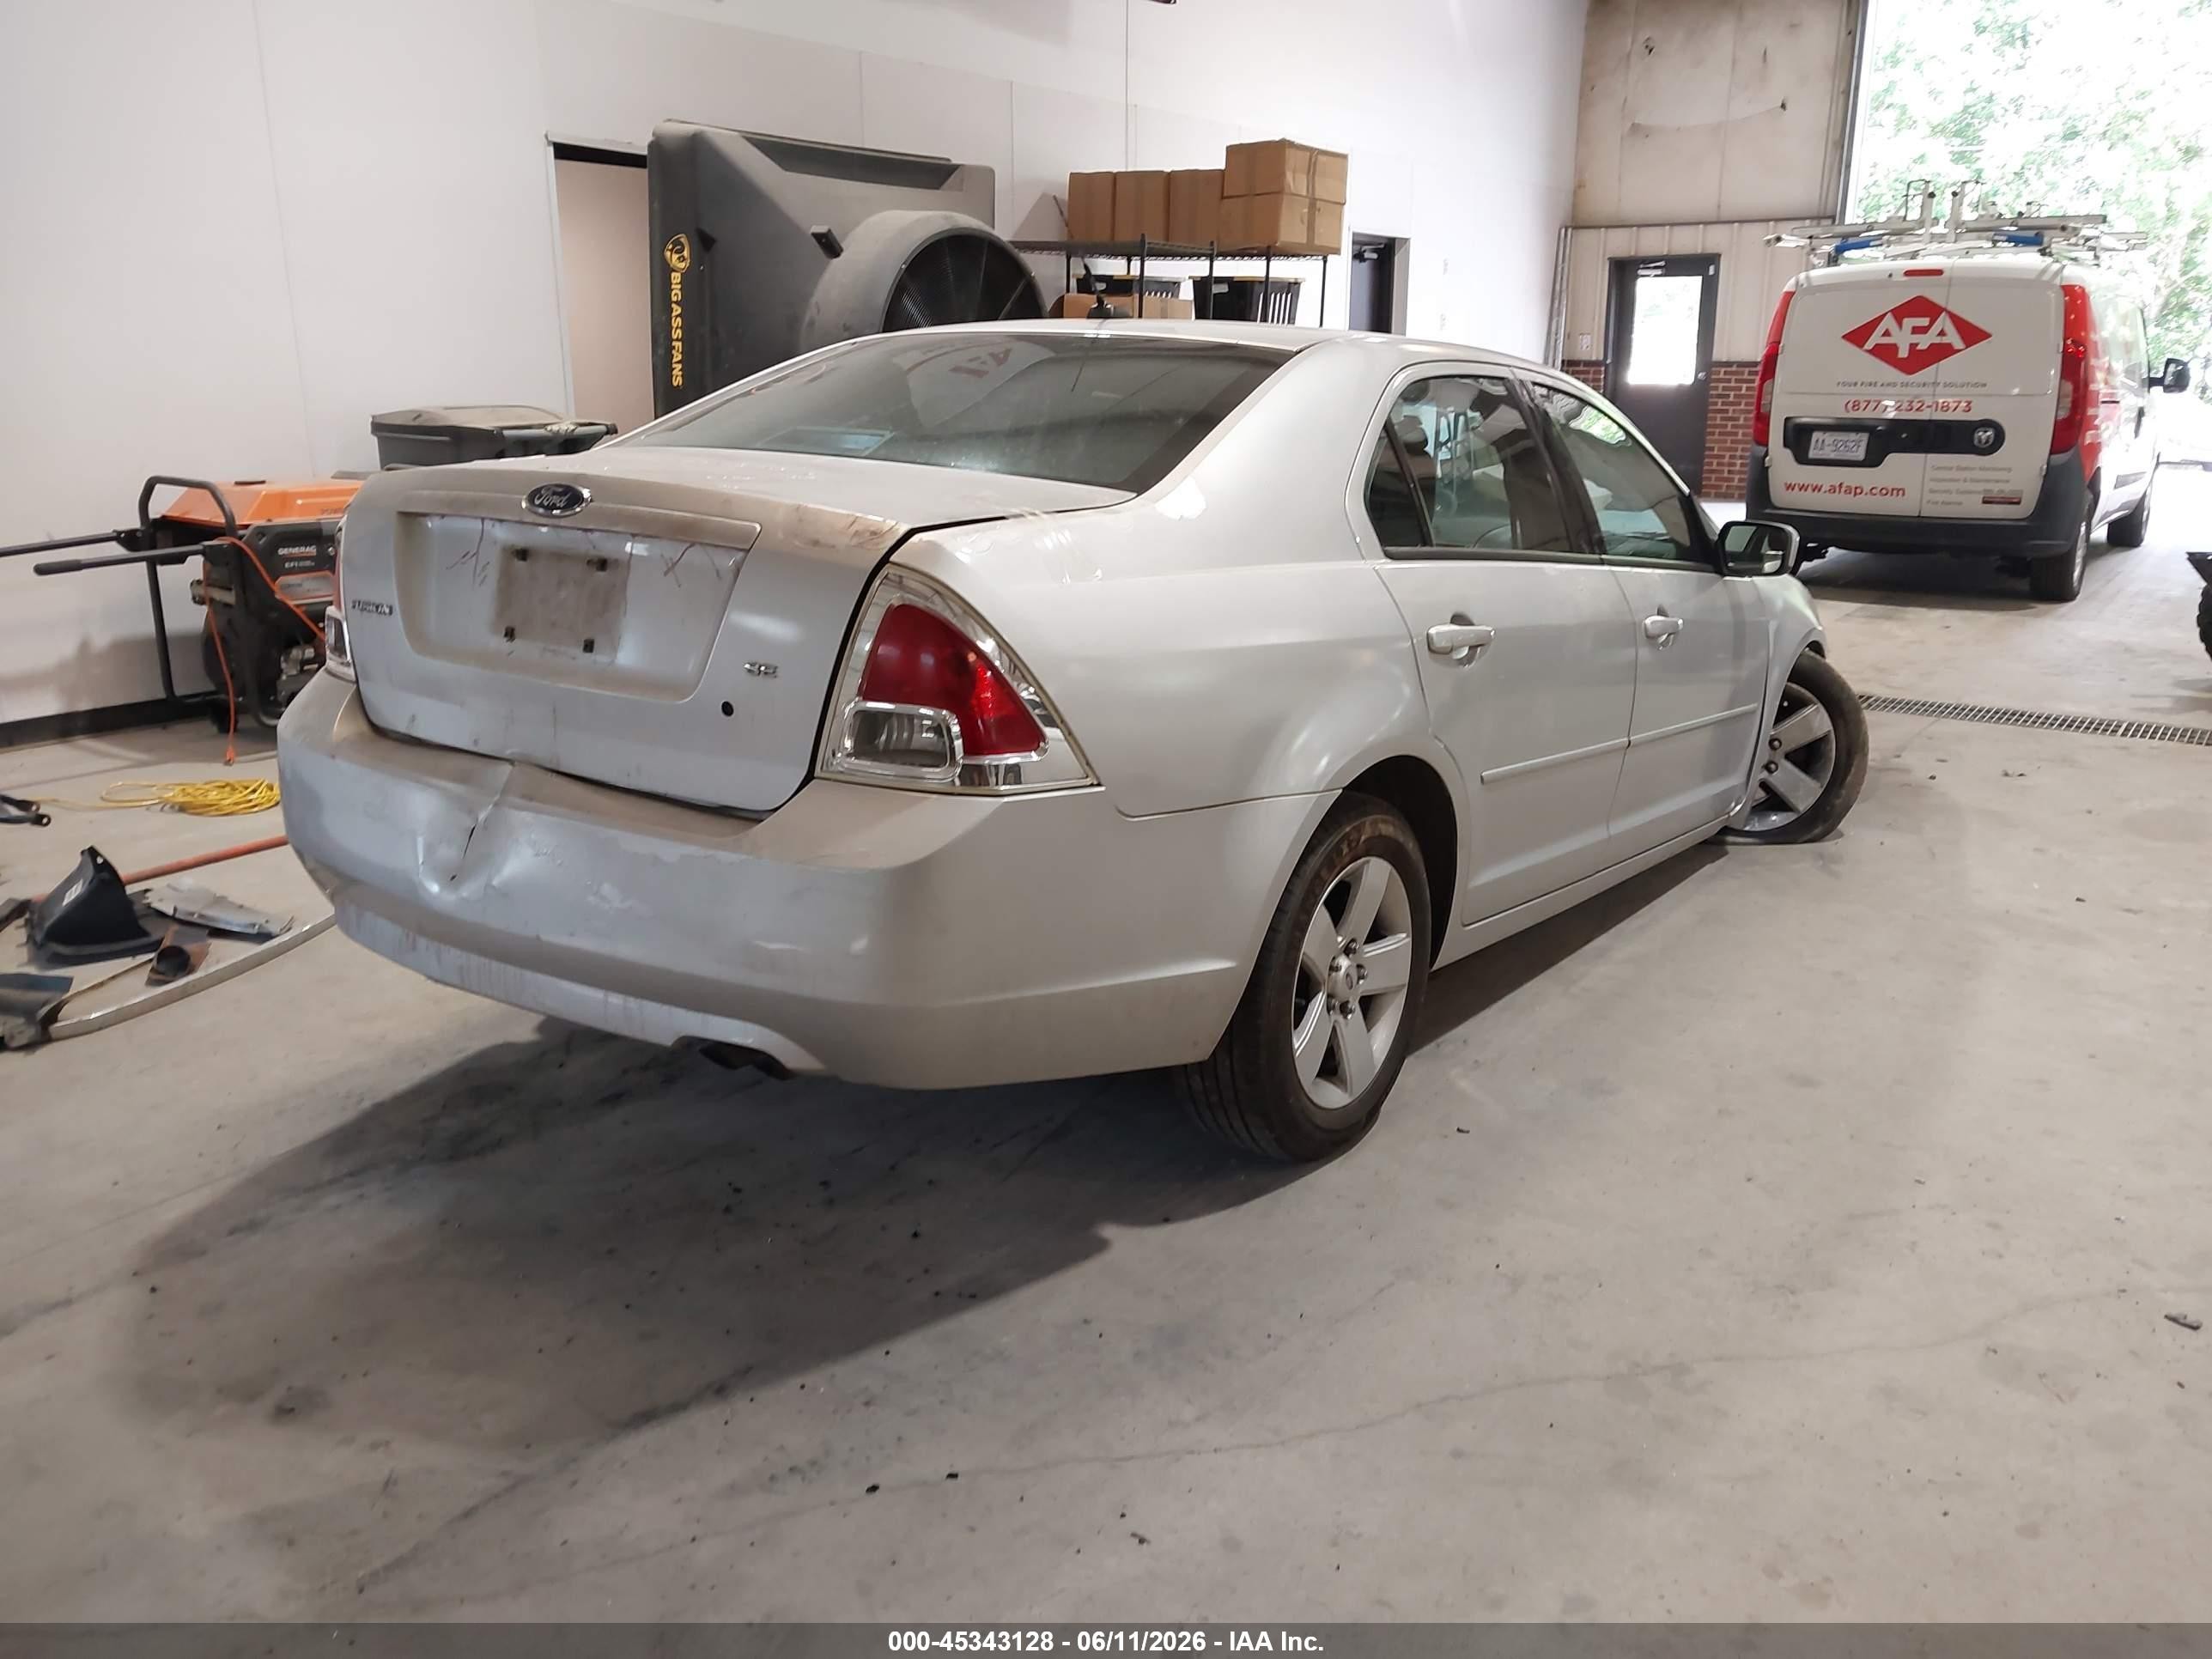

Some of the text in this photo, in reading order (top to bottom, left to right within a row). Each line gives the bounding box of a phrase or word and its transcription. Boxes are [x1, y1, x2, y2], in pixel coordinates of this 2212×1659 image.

[670, 271, 684, 386] BIG ASS FANS
[1862, 311, 1966, 358] AFA
[1844, 399, 1973, 413] (877) 232-1873
[534, 487, 572, 507] Ford
[1784, 482, 1906, 497] www.afap.com
